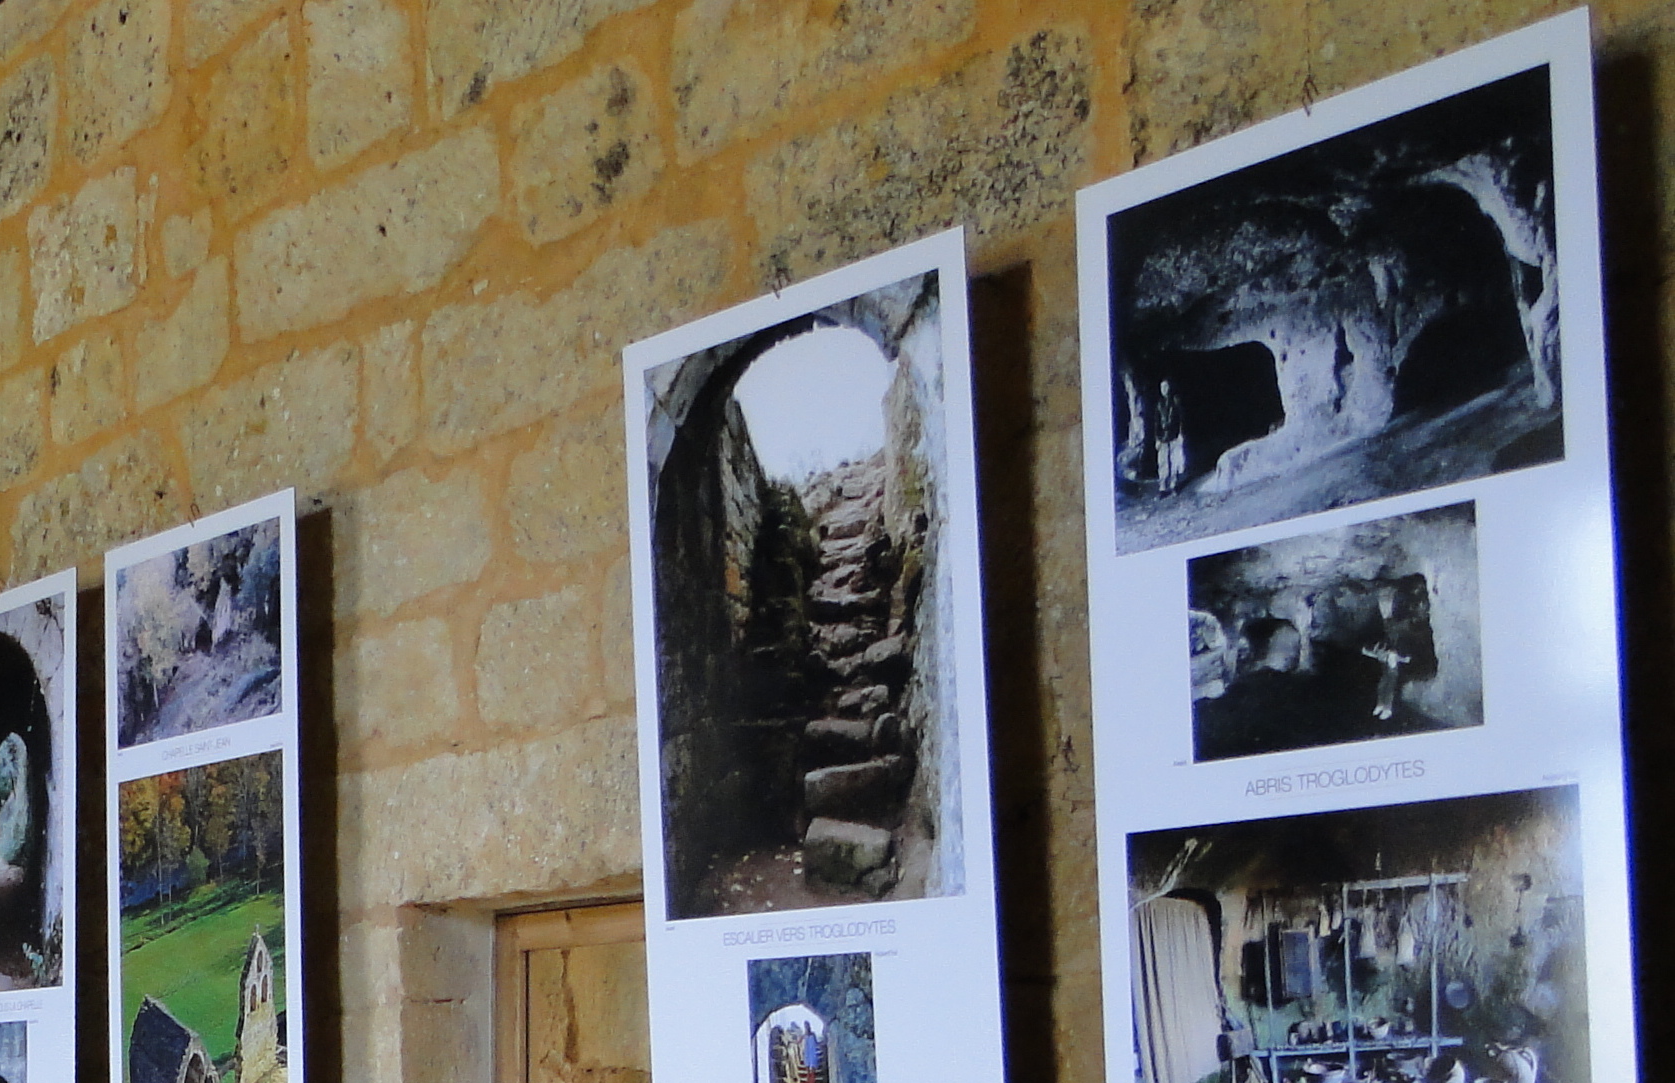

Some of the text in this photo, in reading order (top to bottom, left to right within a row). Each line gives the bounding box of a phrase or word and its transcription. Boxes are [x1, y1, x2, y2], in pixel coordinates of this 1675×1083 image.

[1244, 759, 1425, 797] ABRIS TROGLODYTES
[722, 918, 897, 946] ESCALIER VERS TROGLODYTES
